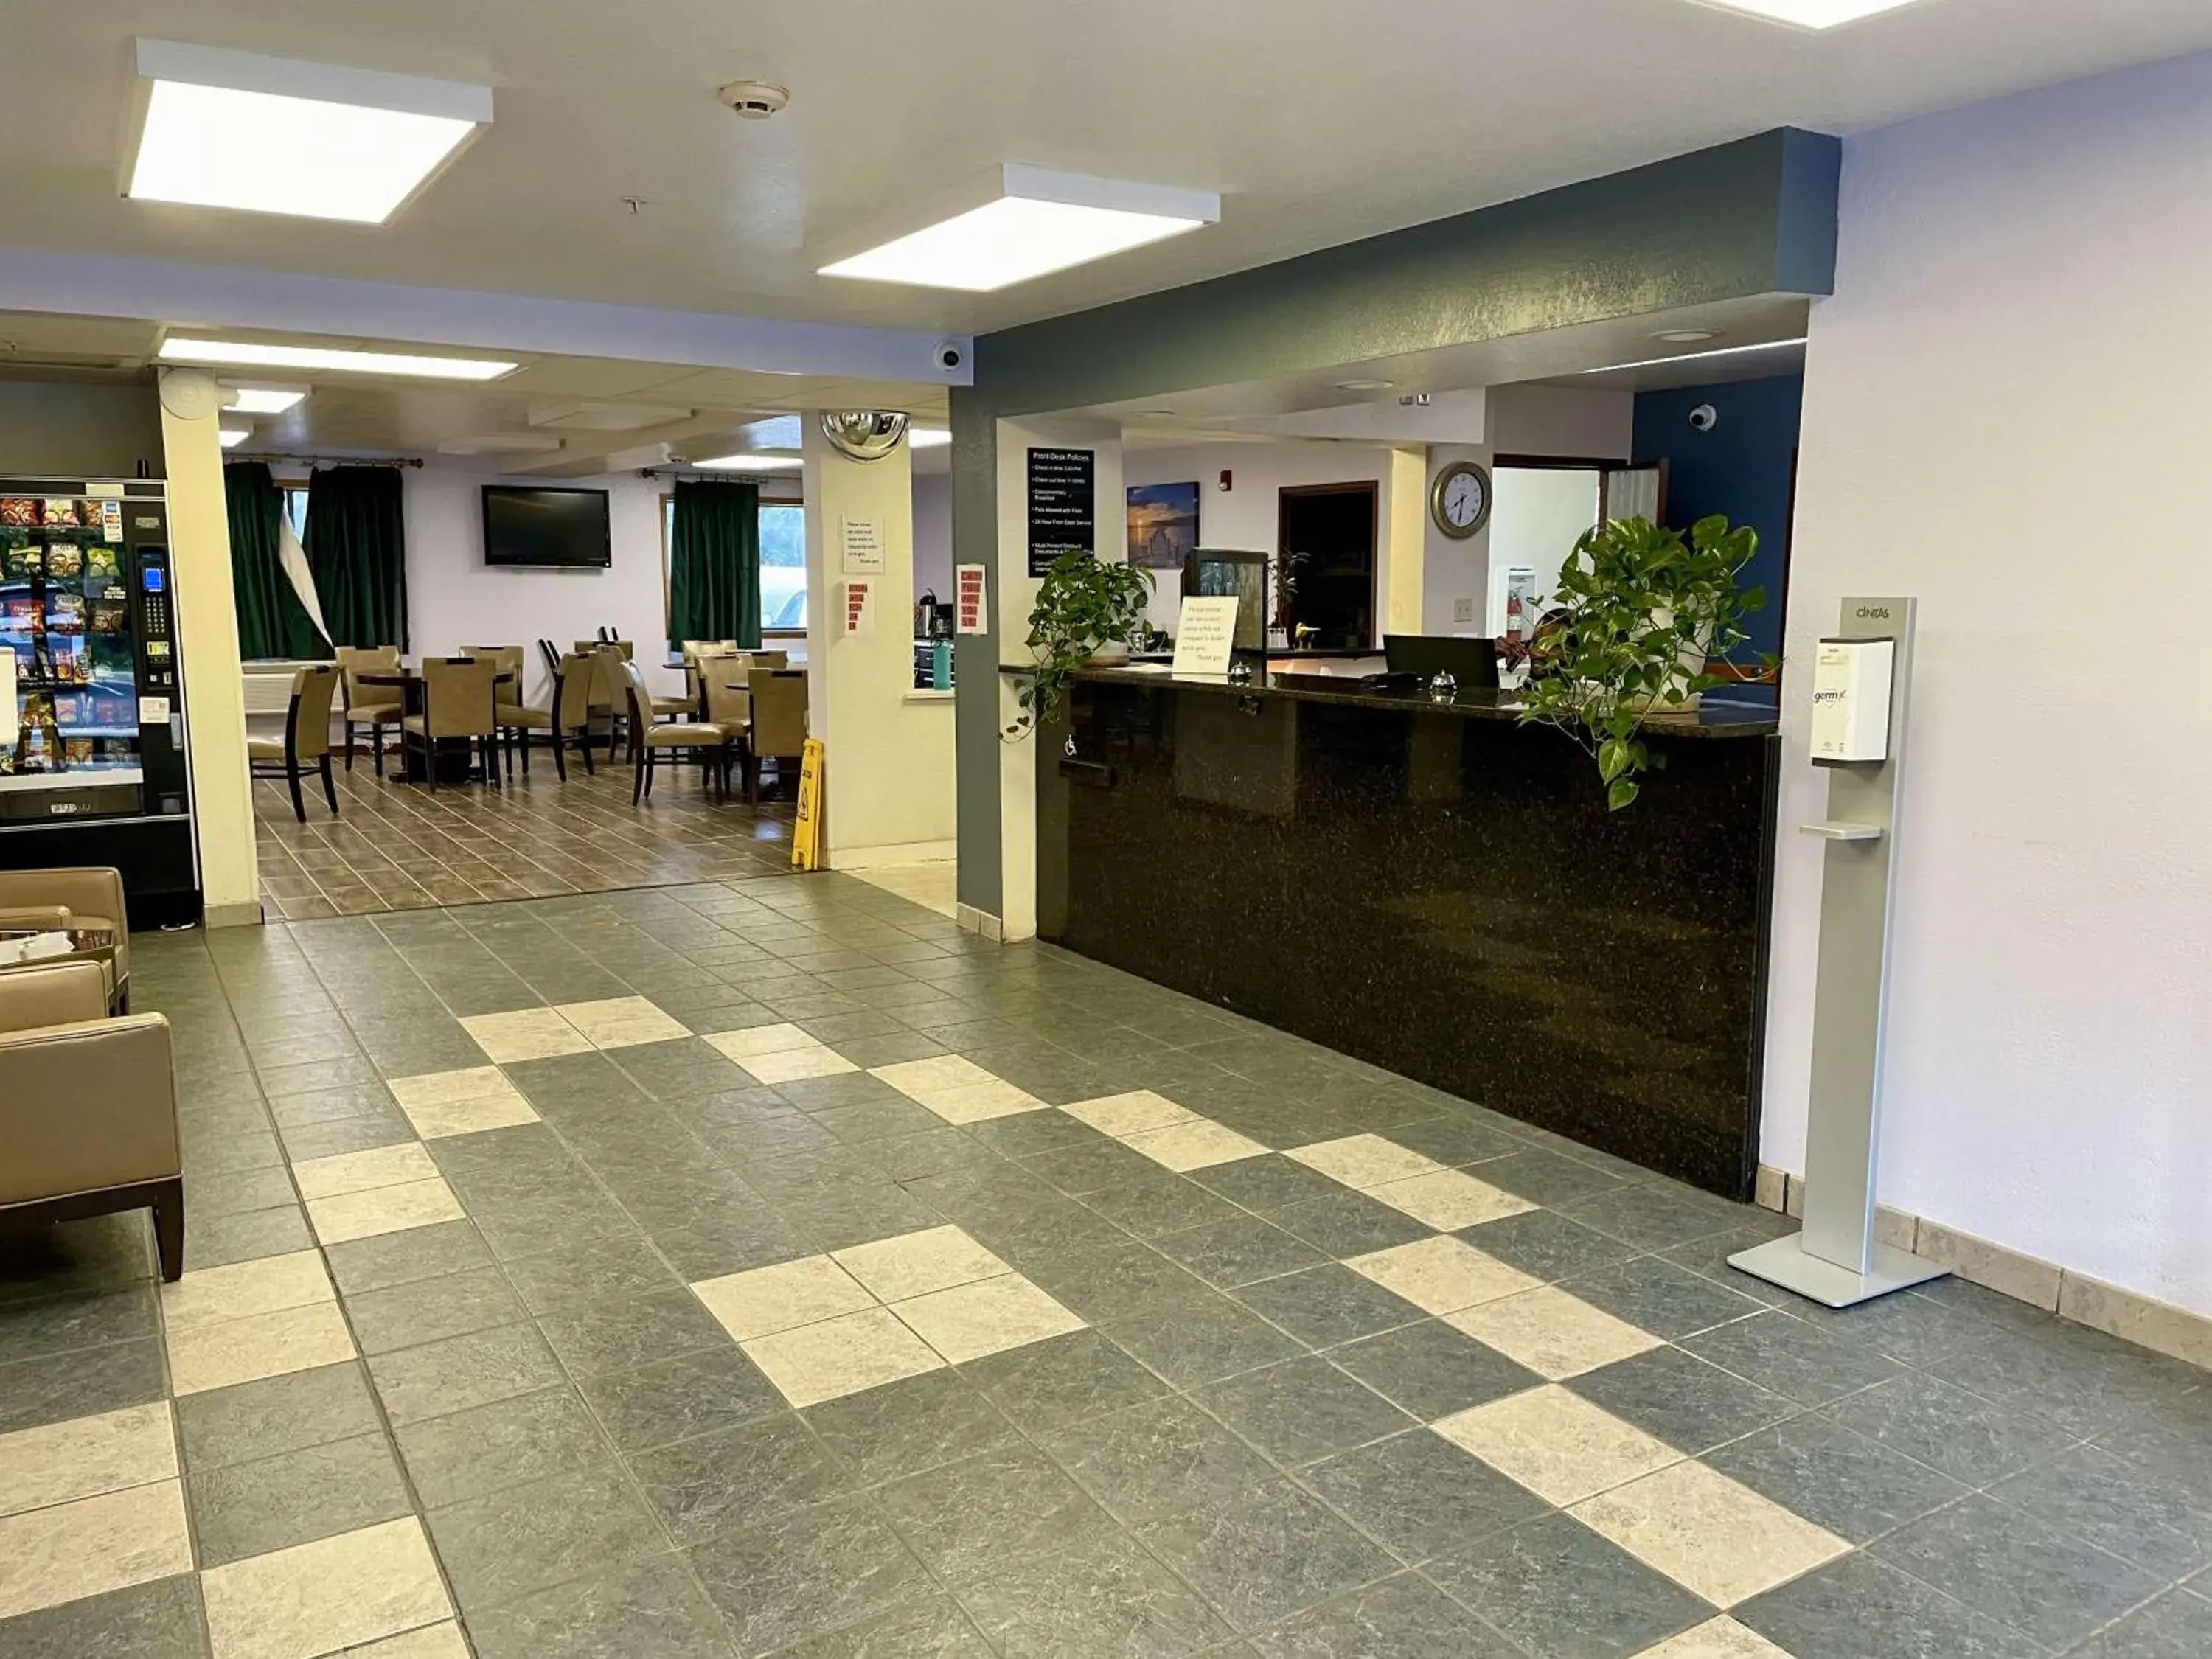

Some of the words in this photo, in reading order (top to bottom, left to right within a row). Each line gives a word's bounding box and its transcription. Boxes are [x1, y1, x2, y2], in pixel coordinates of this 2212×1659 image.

[1033, 452, 1048, 460] Front
[1050, 453, 1065, 461] Desk
[1067, 453, 1089, 462] Policies
